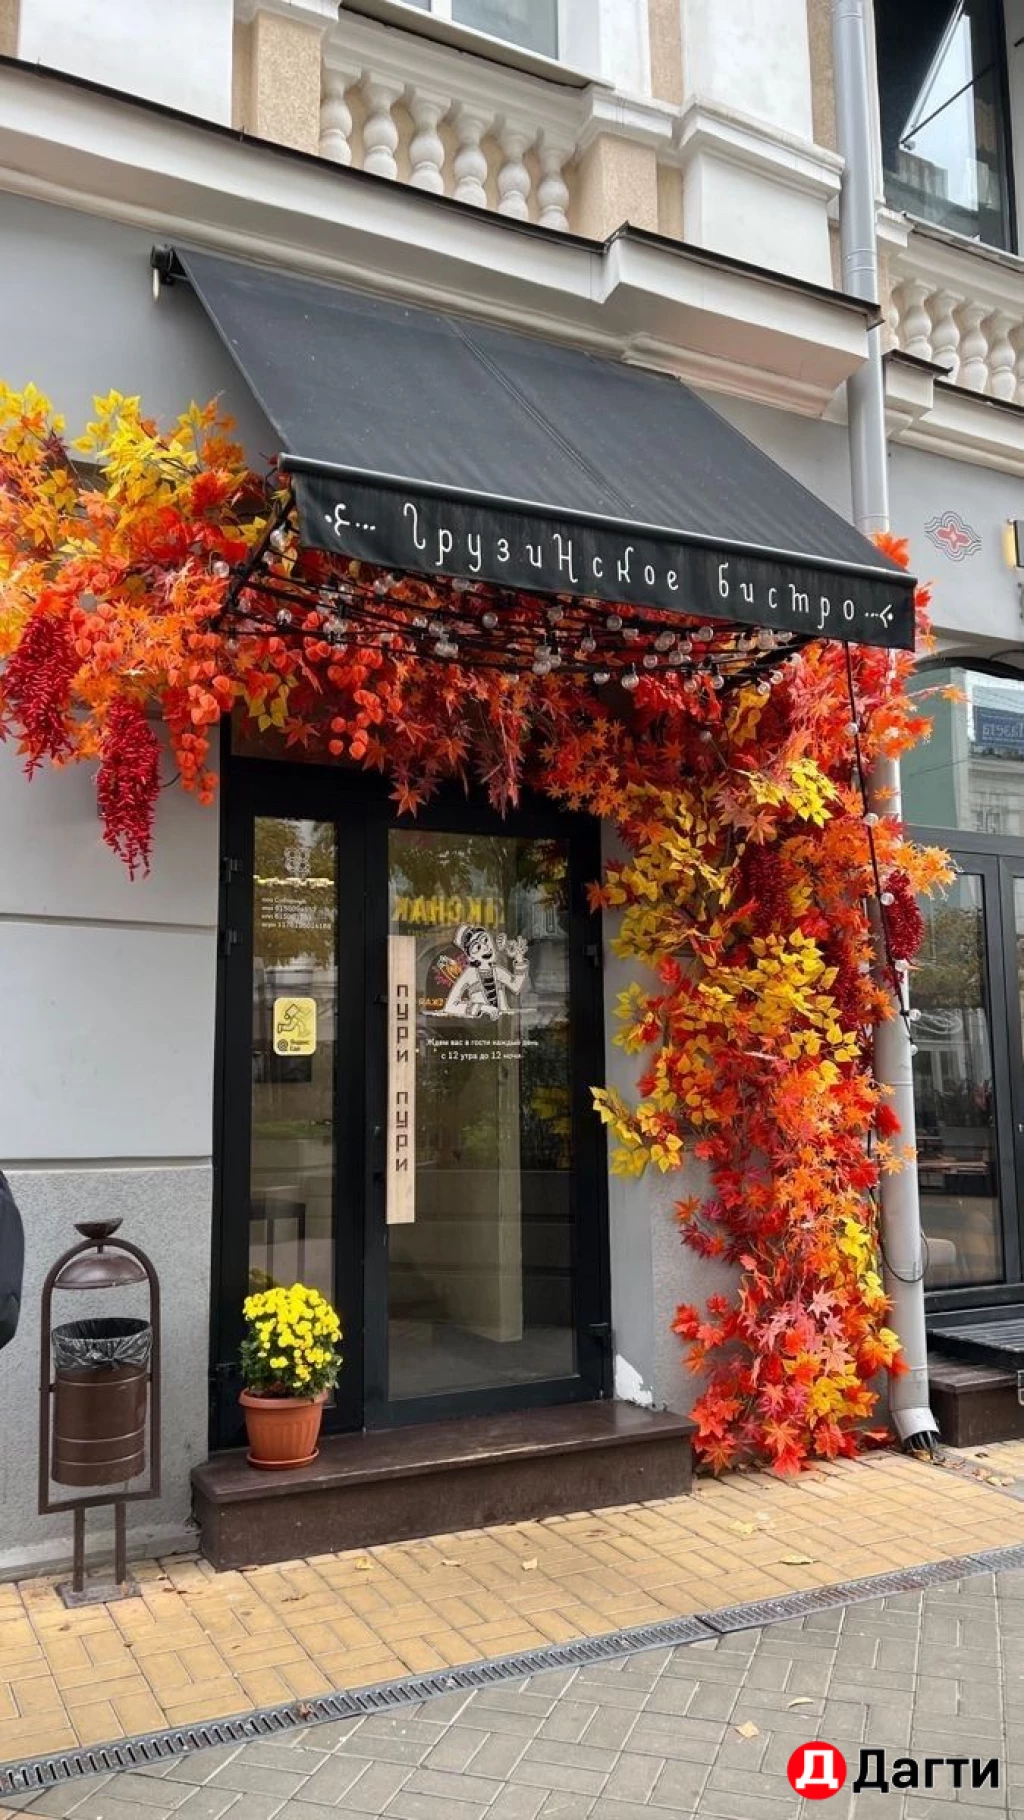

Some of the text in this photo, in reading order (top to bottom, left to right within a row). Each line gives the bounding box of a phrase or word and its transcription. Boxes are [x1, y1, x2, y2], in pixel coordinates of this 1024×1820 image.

[402, 503, 855, 629] Грузинское бистро
[448, 1051, 458, 1059] 12
[491, 1051, 501, 1059] 12
